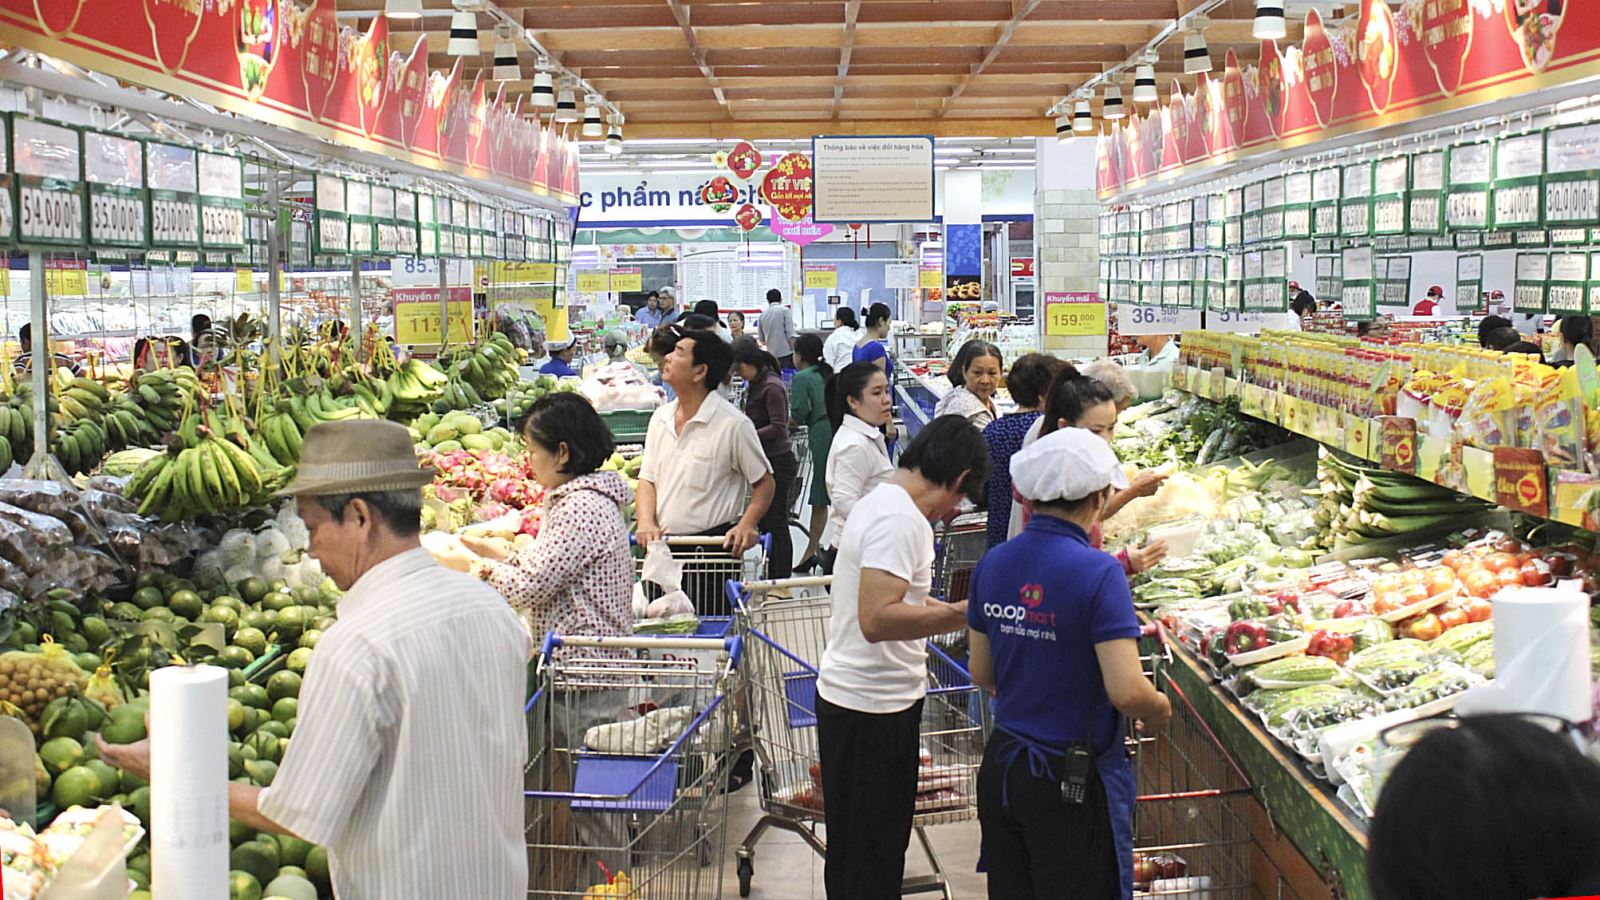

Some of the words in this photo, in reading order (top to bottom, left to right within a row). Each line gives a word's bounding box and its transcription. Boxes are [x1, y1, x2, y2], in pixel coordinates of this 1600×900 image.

[823, 144, 843, 153] Thông
[845, 143, 857, 151] báo
[868, 143, 880, 152] việc
[894, 143, 910, 153] hàng
[771, 176, 791, 190] TẾT
[793, 177, 812, 192] VIỆ
[601, 180, 671, 212] phẩm
[396, 291, 432, 302] Khuyến
[434, 291, 451, 301] mi
[1047, 294, 1074, 306] Khuyến
[1076, 294, 1090, 304] mãi
